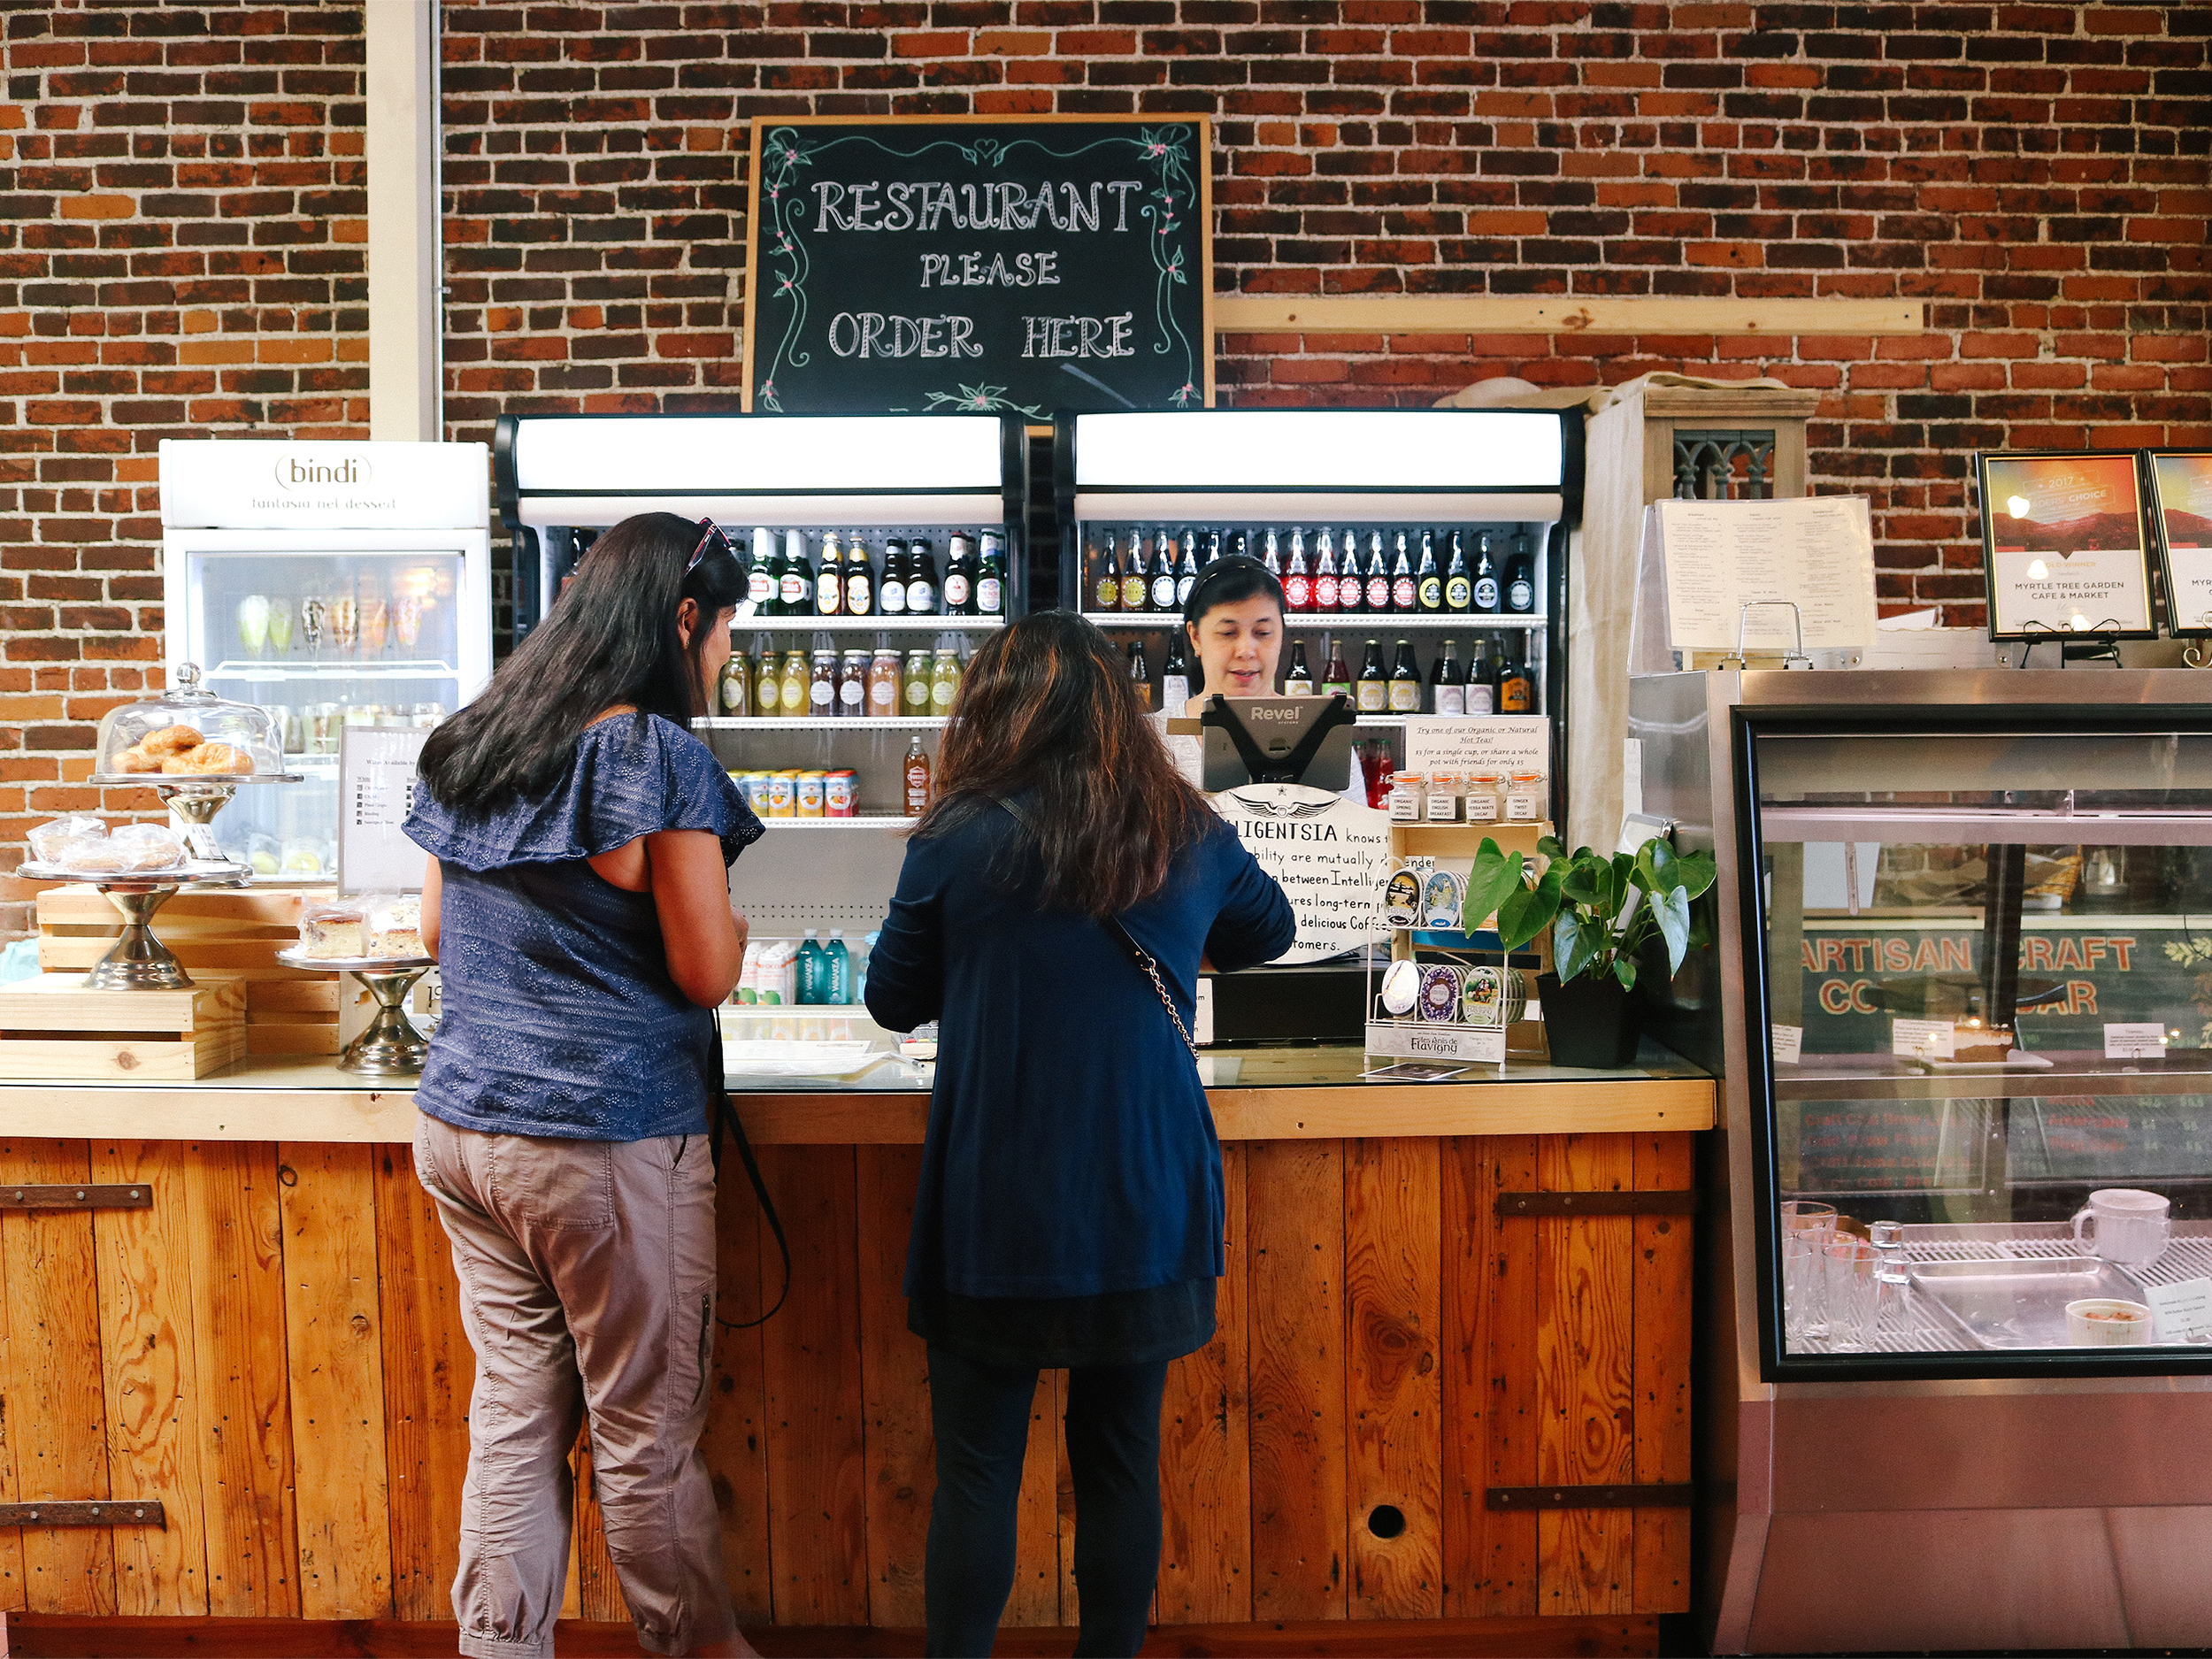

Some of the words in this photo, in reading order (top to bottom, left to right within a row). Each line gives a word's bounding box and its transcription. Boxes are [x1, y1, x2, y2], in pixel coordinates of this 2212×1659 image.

[811, 180, 1142, 233] RESTAURANT
[919, 250, 1062, 288] PLEASE
[828, 311, 984, 358] ORDER
[1020, 311, 1136, 358] HERE
[290, 458, 357, 483] bindi
[2048, 476, 2074, 488] 2017
[252, 496, 311, 510] fantasia
[2068, 489, 2108, 503] CHOICE
[1250, 706, 1300, 720] Revel
[1417, 726, 1430, 735] Try
[1445, 726, 1454, 735] of
[1468, 726, 1496, 735] Organic
[1507, 725, 1540, 734] Natural
[1423, 748, 1434, 757] for
[1442, 748, 1463, 757] single
[1429, 758, 1441, 767] pot
[1459, 758, 1486, 767] friends
[1486, 758, 1497, 767] for
[1499, 758, 1515, 767] only
[1227, 819, 1338, 841] LIGENTSIA
[1346, 827, 1381, 844] knows
[1253, 846, 1286, 865] bility
[1291, 853, 1312, 863] are
[1317, 850, 1373, 869] mutually
[1281, 868, 1329, 885] between
[1287, 897, 1312, 907] ures
[1301, 913, 1347, 929] delicious
[1293, 938, 1340, 951] tomers.
[1801, 938, 1973, 972] ARTISAN
[804, 956, 813, 991] WAIAKEA
[1410, 1037, 1458, 1056] Flavigny
